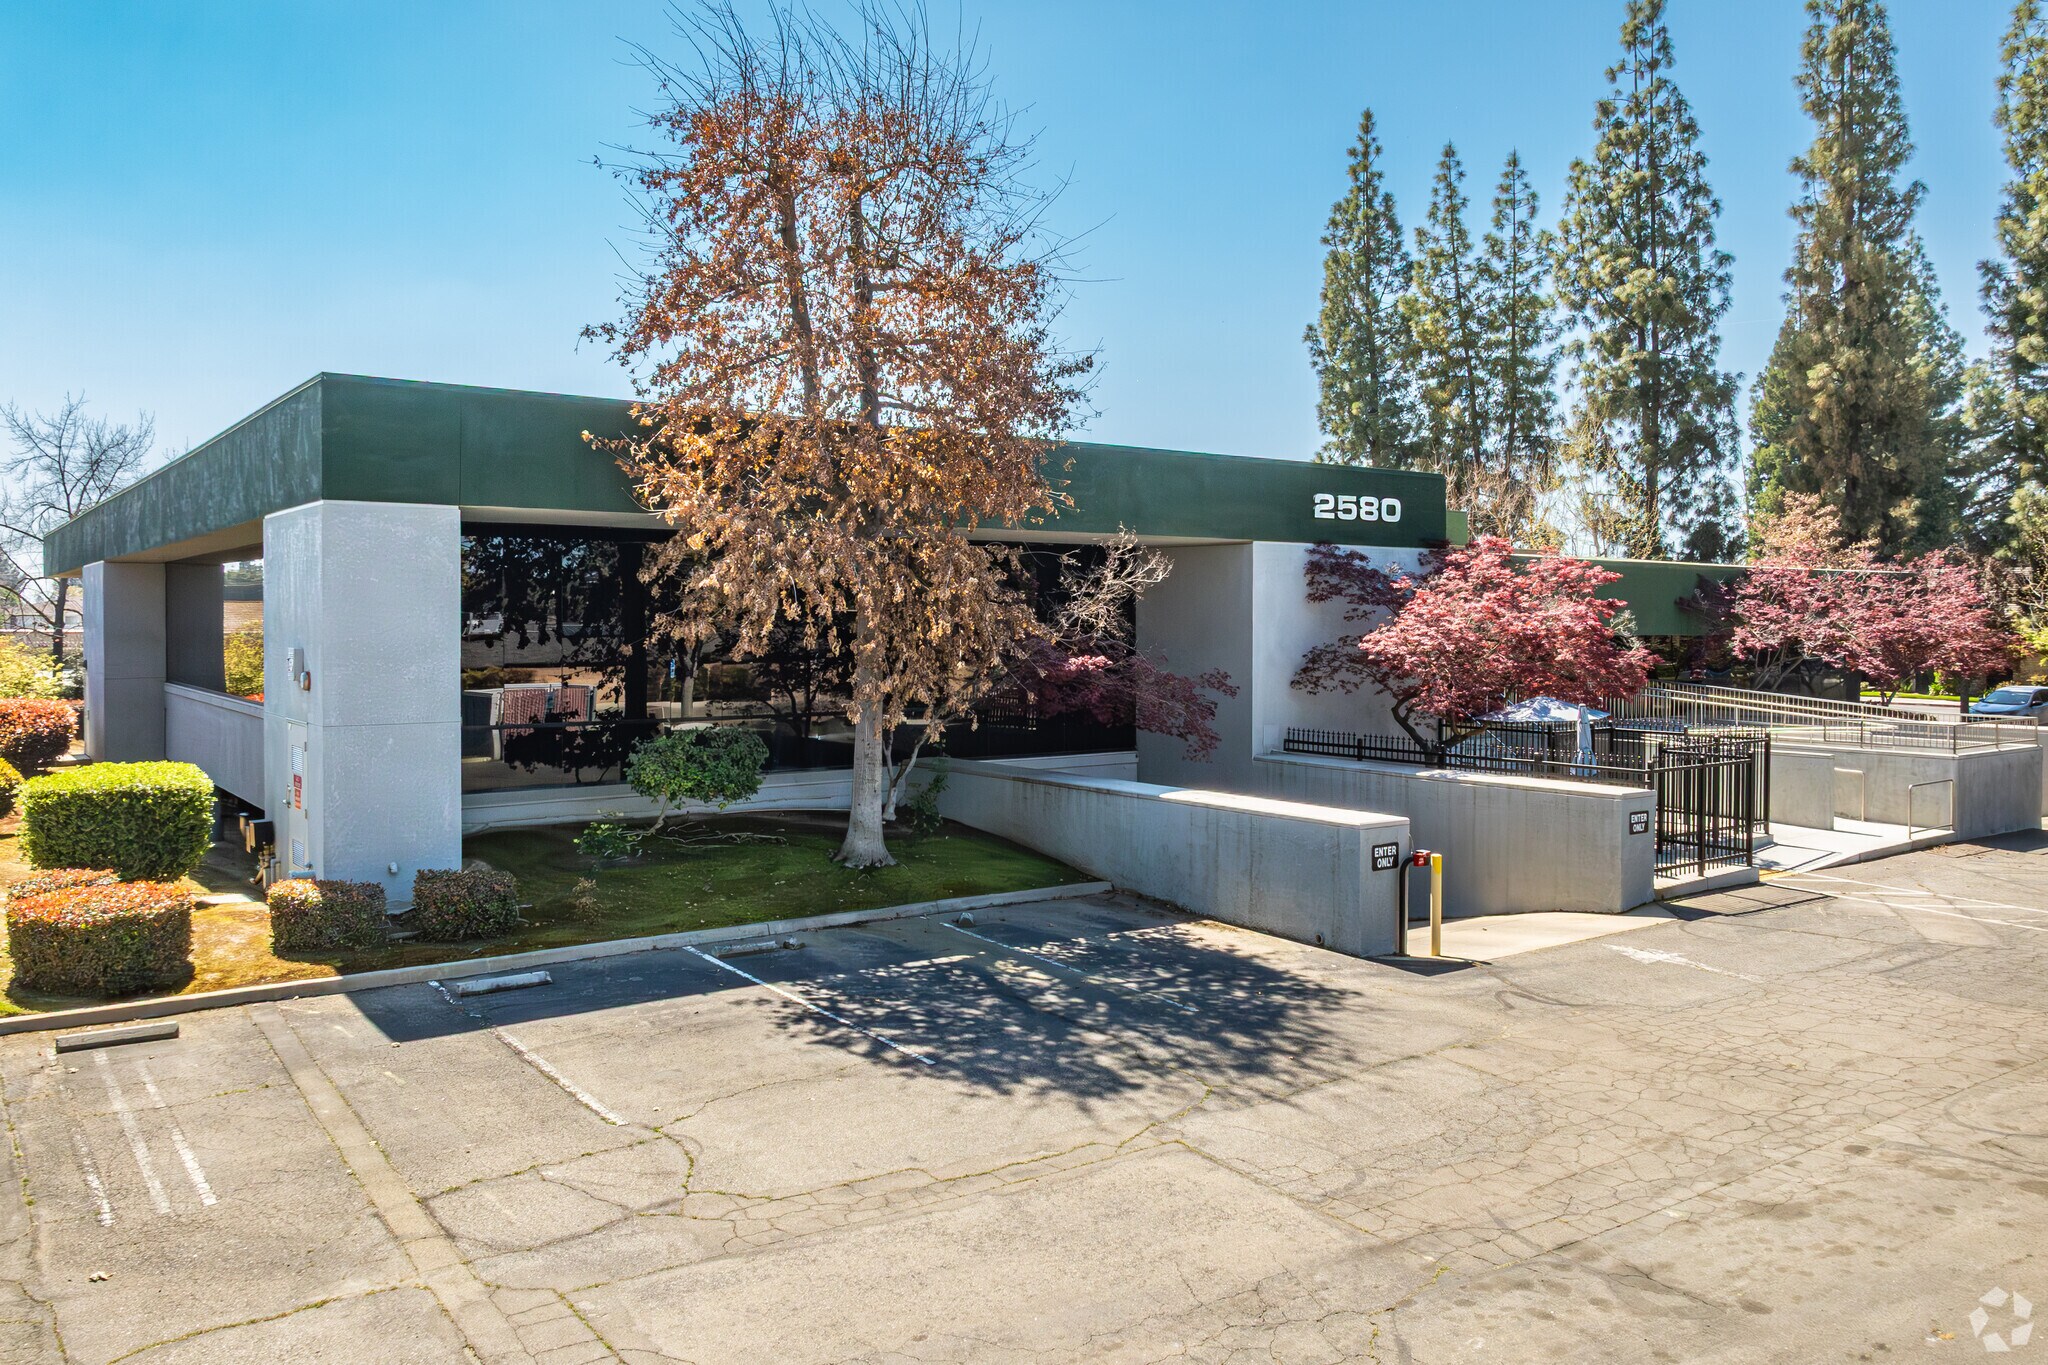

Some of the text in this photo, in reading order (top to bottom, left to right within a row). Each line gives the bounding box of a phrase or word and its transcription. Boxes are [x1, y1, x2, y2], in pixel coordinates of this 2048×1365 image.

[1313, 493, 1401, 522] 2580
[1631, 813, 1648, 823] ENTER
[1632, 823, 1646, 832] ONLY
[1374, 845, 1397, 858] ENTER
[1376, 857, 1394, 868] ONLY
